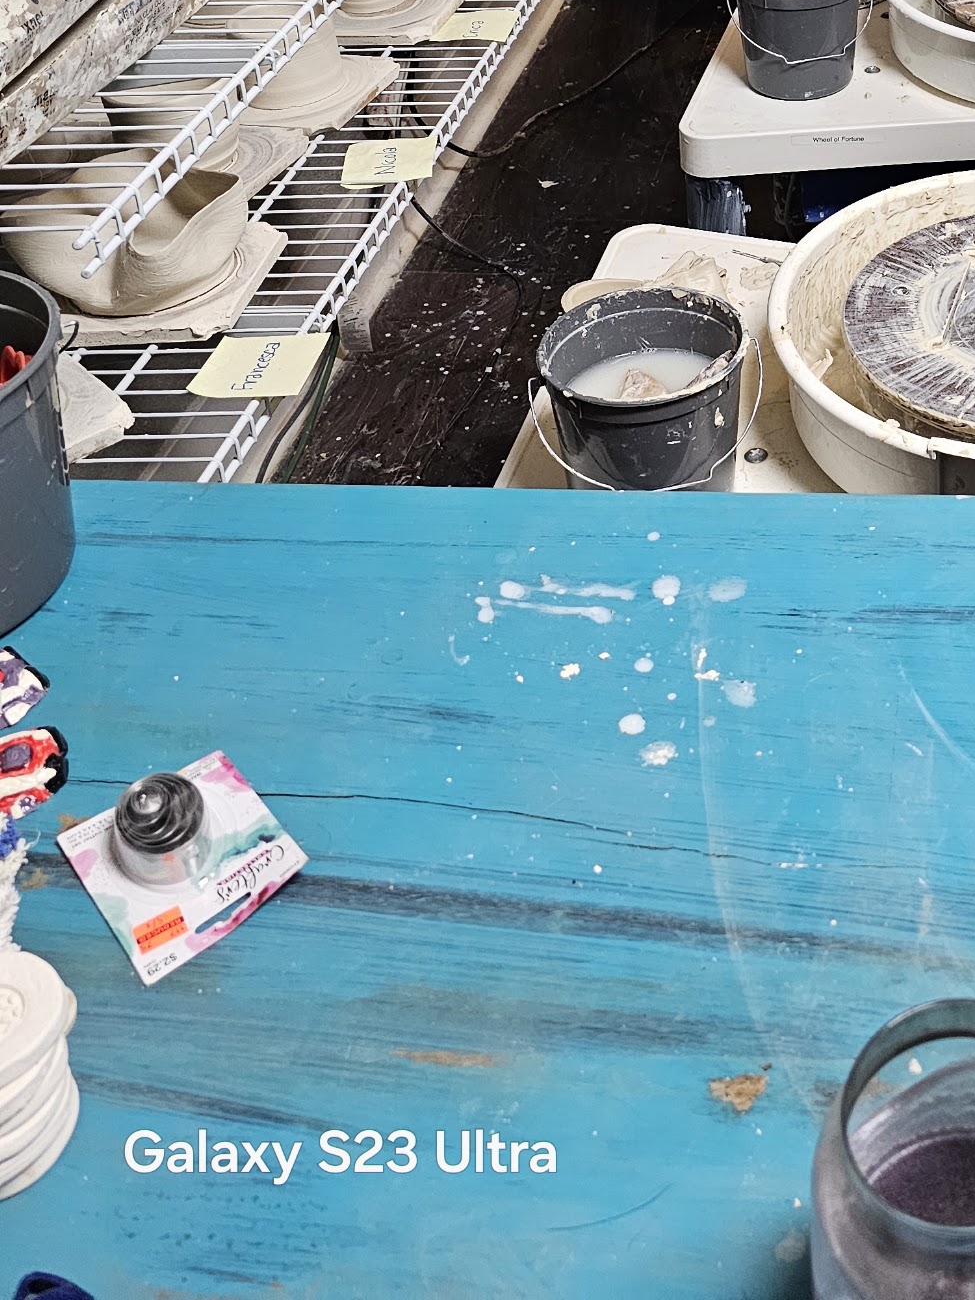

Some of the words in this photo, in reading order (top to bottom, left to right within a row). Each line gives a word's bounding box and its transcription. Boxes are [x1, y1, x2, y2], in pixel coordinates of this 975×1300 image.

[374, 146, 398, 176] Nicola
[230, 341, 281, 391] Francesca
[216, 844, 285, 904] Crafter's
[146, 952, 178, 976] $2.29
